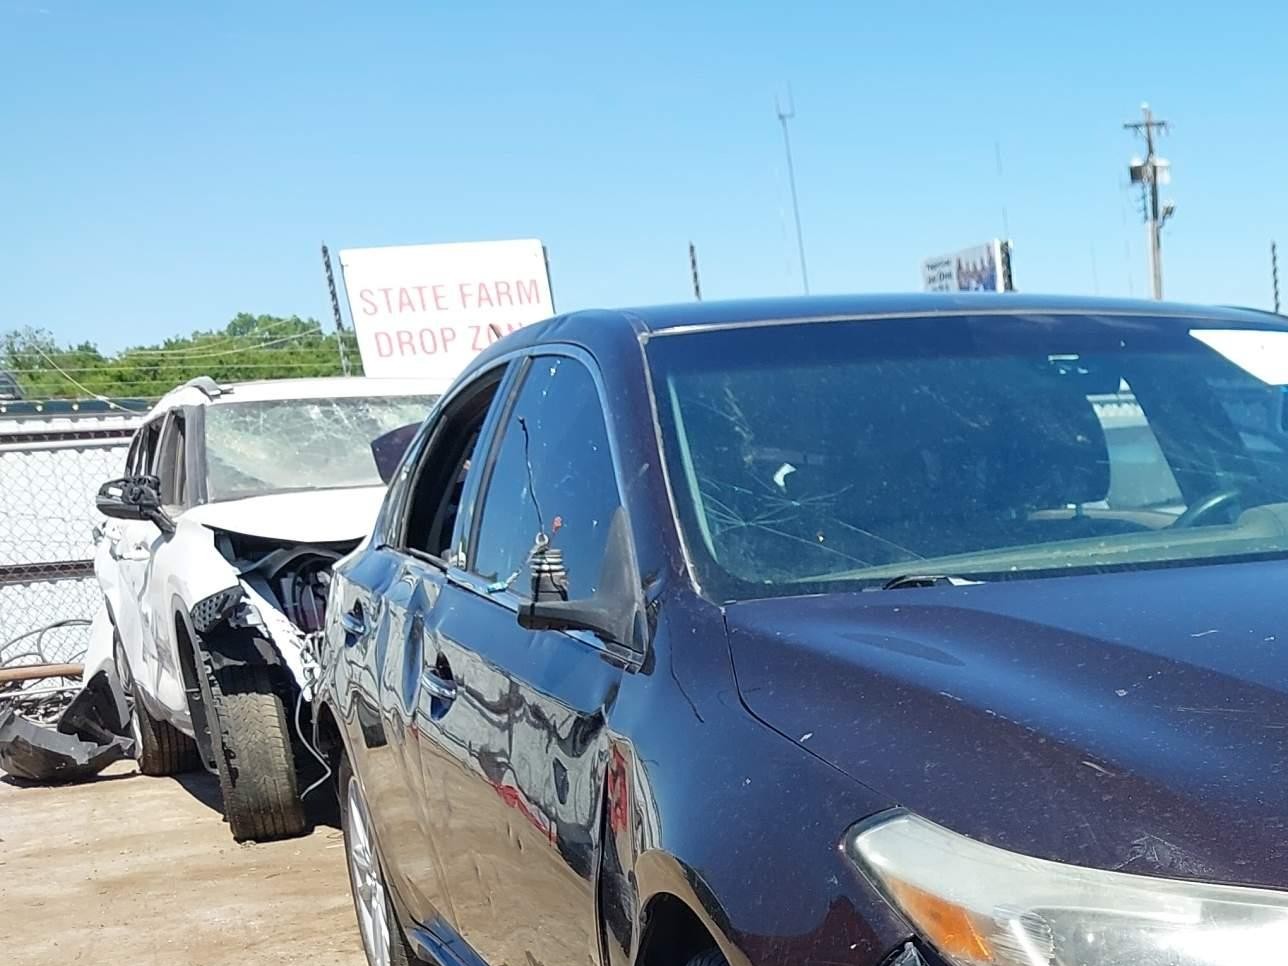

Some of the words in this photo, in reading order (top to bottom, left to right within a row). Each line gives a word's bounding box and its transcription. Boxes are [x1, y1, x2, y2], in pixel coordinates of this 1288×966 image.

[359, 284, 449, 317] STATE
[458, 278, 541, 309] FARM
[374, 326, 457, 358] DROP
